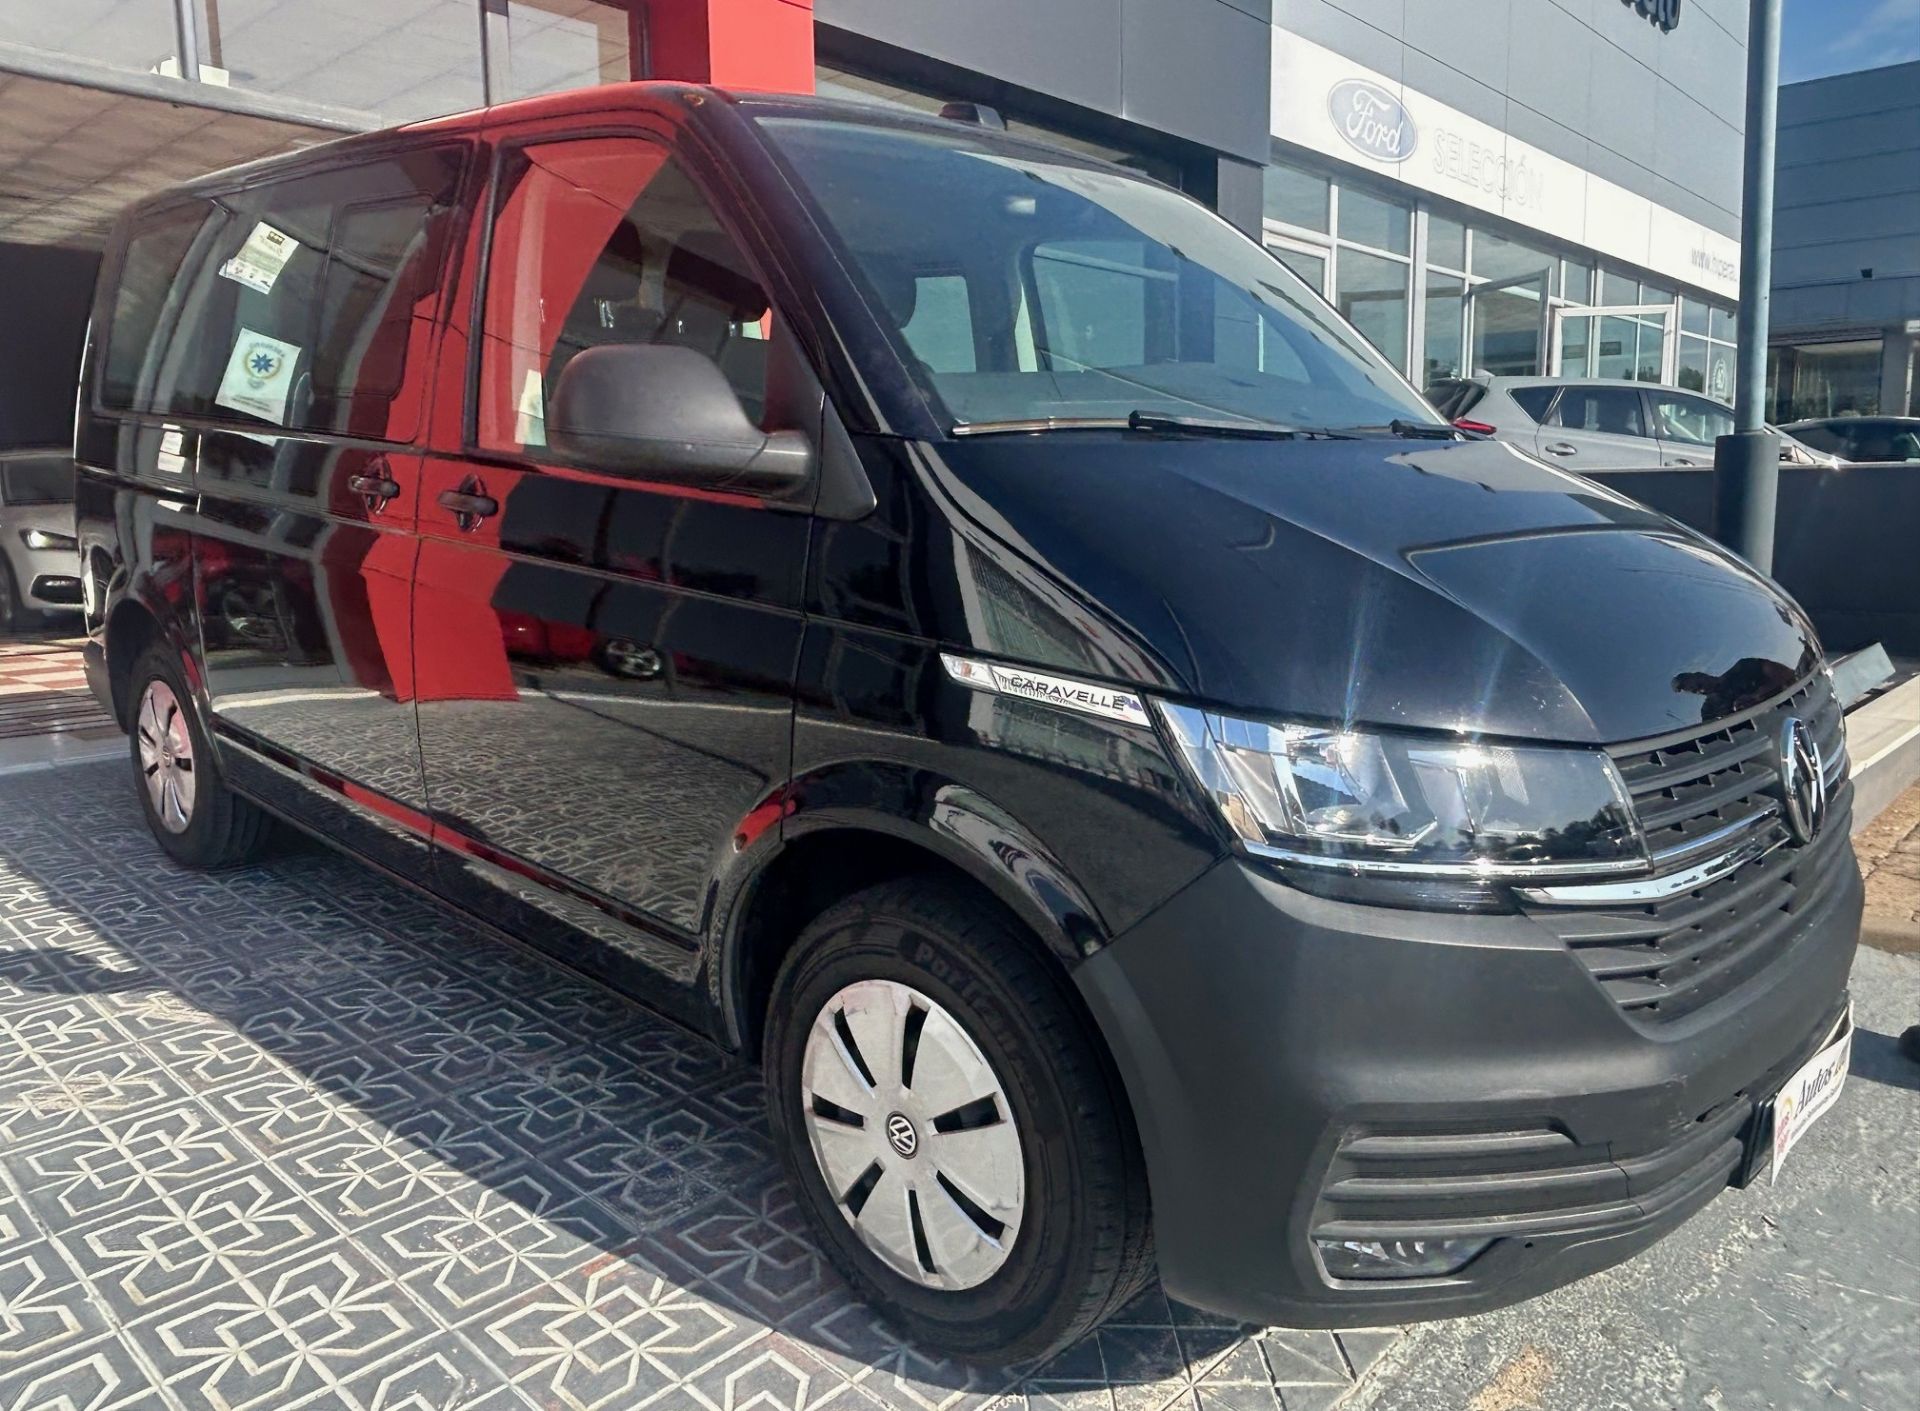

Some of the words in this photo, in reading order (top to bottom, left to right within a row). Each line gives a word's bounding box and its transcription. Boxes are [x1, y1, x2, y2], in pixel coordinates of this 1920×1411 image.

[1346, 89, 1403, 154] Ford
[1432, 127, 1544, 210] SELECCIÓN
[1010, 675, 1125, 711] CARAVELLE
[1794, 1061, 1836, 1119] Autos
